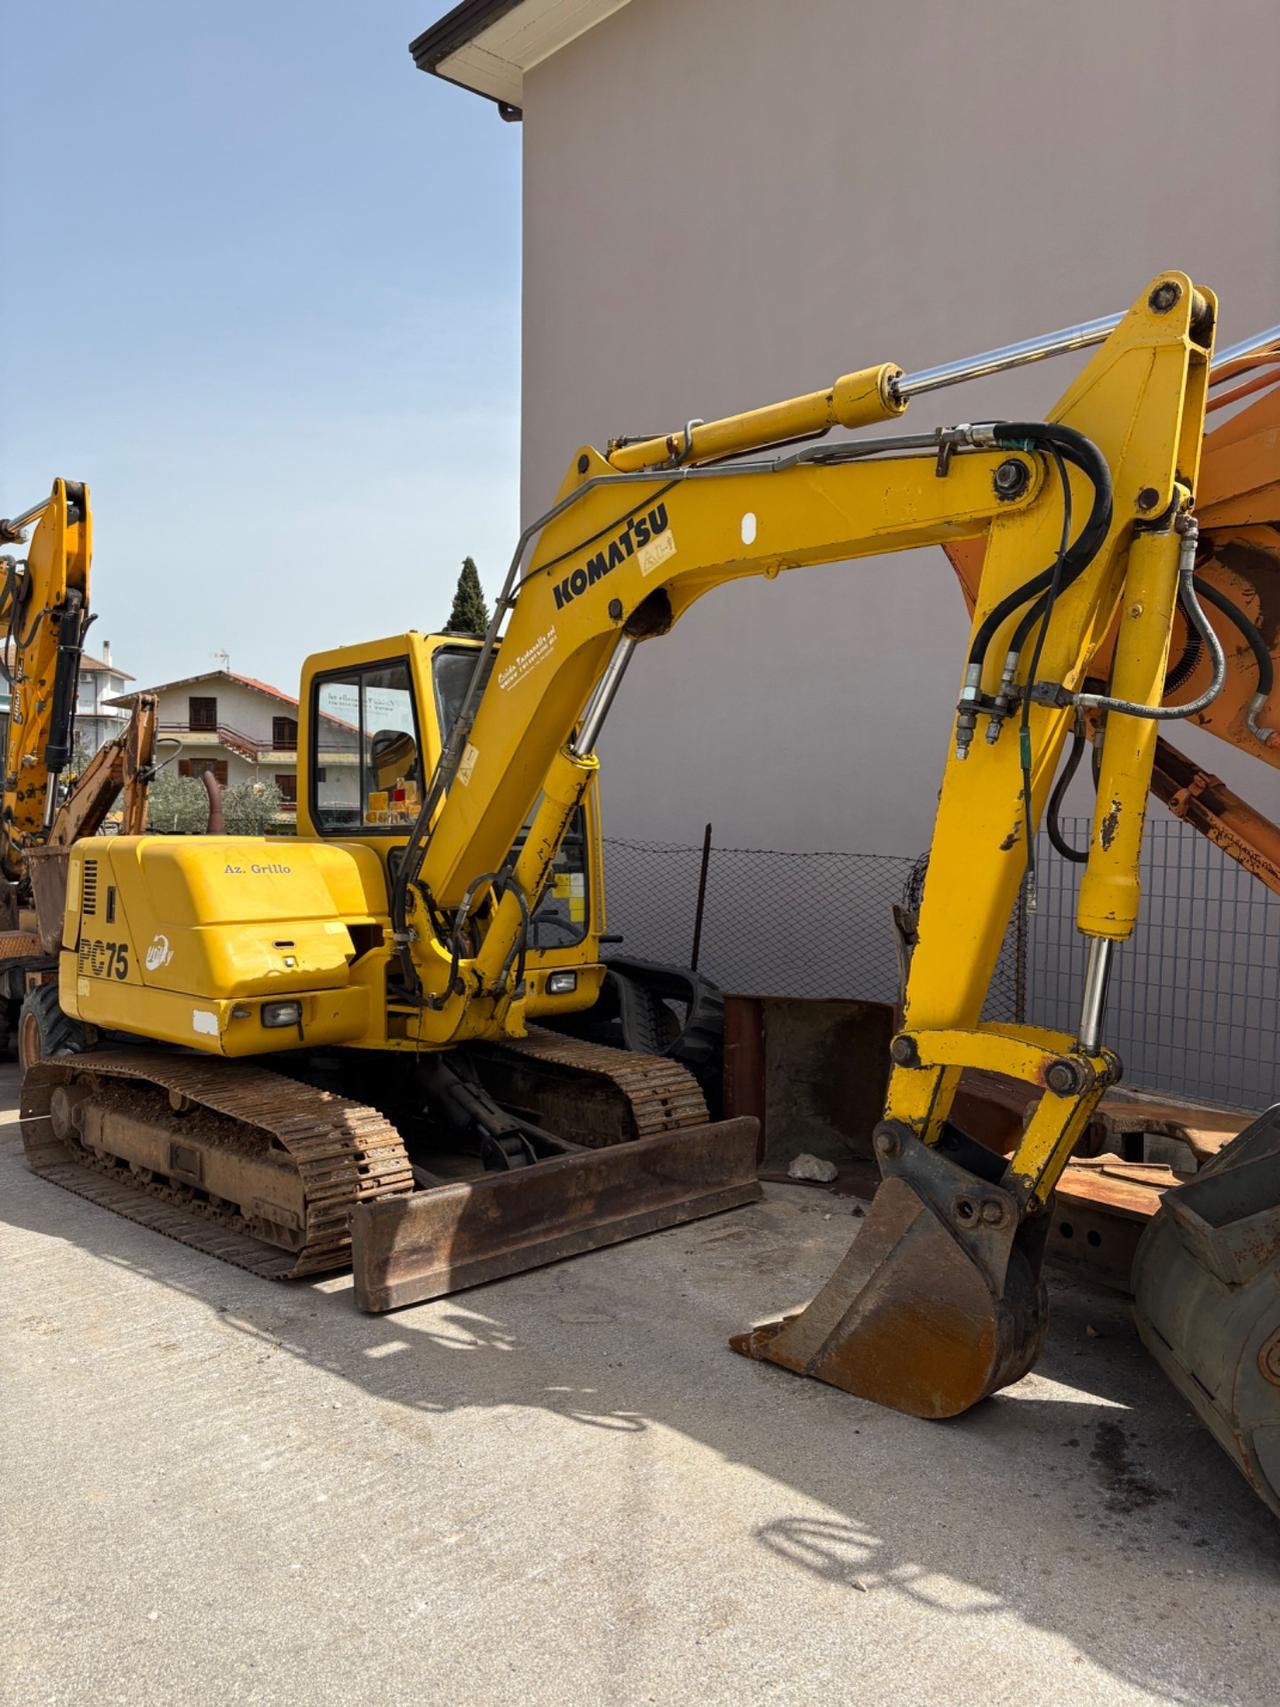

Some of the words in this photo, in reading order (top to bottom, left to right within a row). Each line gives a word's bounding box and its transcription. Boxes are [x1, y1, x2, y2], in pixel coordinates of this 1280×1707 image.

[552, 502, 669, 611] KOMATSU
[224, 864, 247, 874] Az.
[250, 863, 291, 874] Grillo
